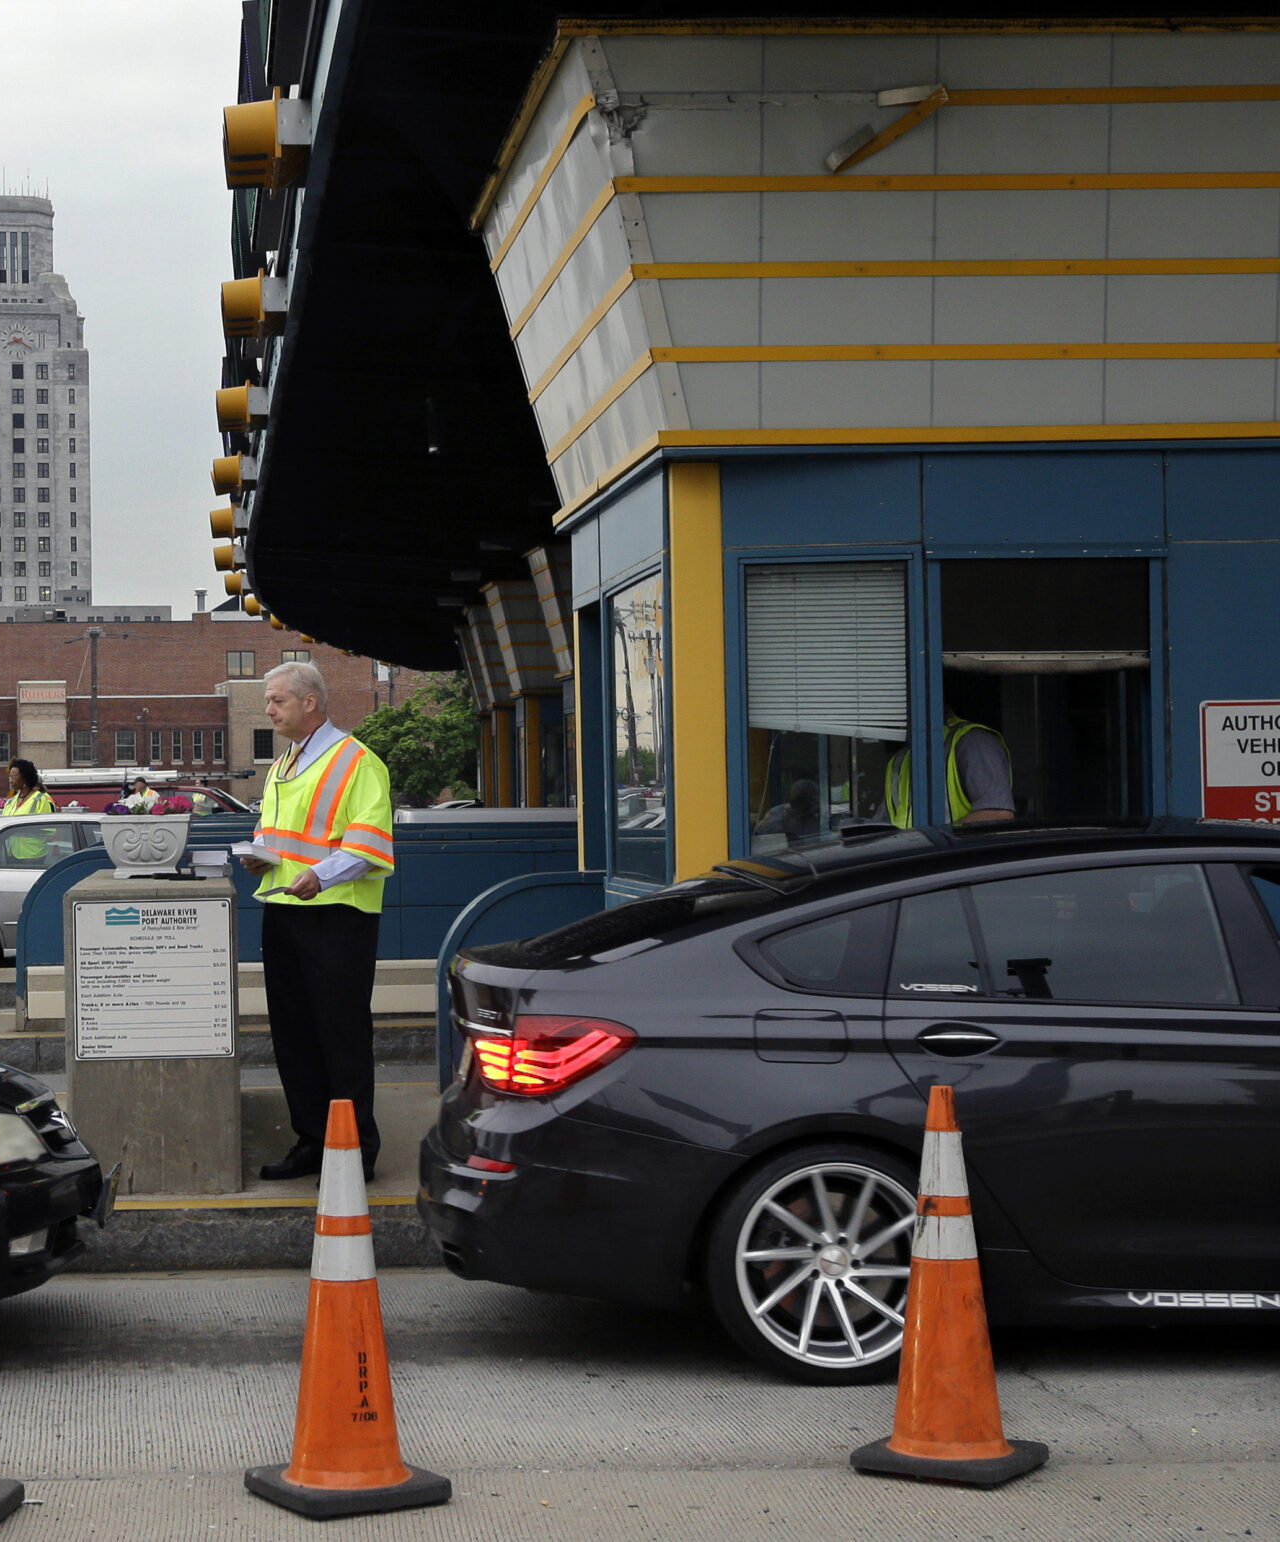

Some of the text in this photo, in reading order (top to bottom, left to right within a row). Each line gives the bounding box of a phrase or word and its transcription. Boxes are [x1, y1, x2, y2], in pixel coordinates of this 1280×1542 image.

[1261, 760, 1280, 776] O
[900, 983, 978, 992] VOSSEN
[1128, 1291, 1280, 1308] VOSSEN
[358, 1352, 369, 1408] DRPA
